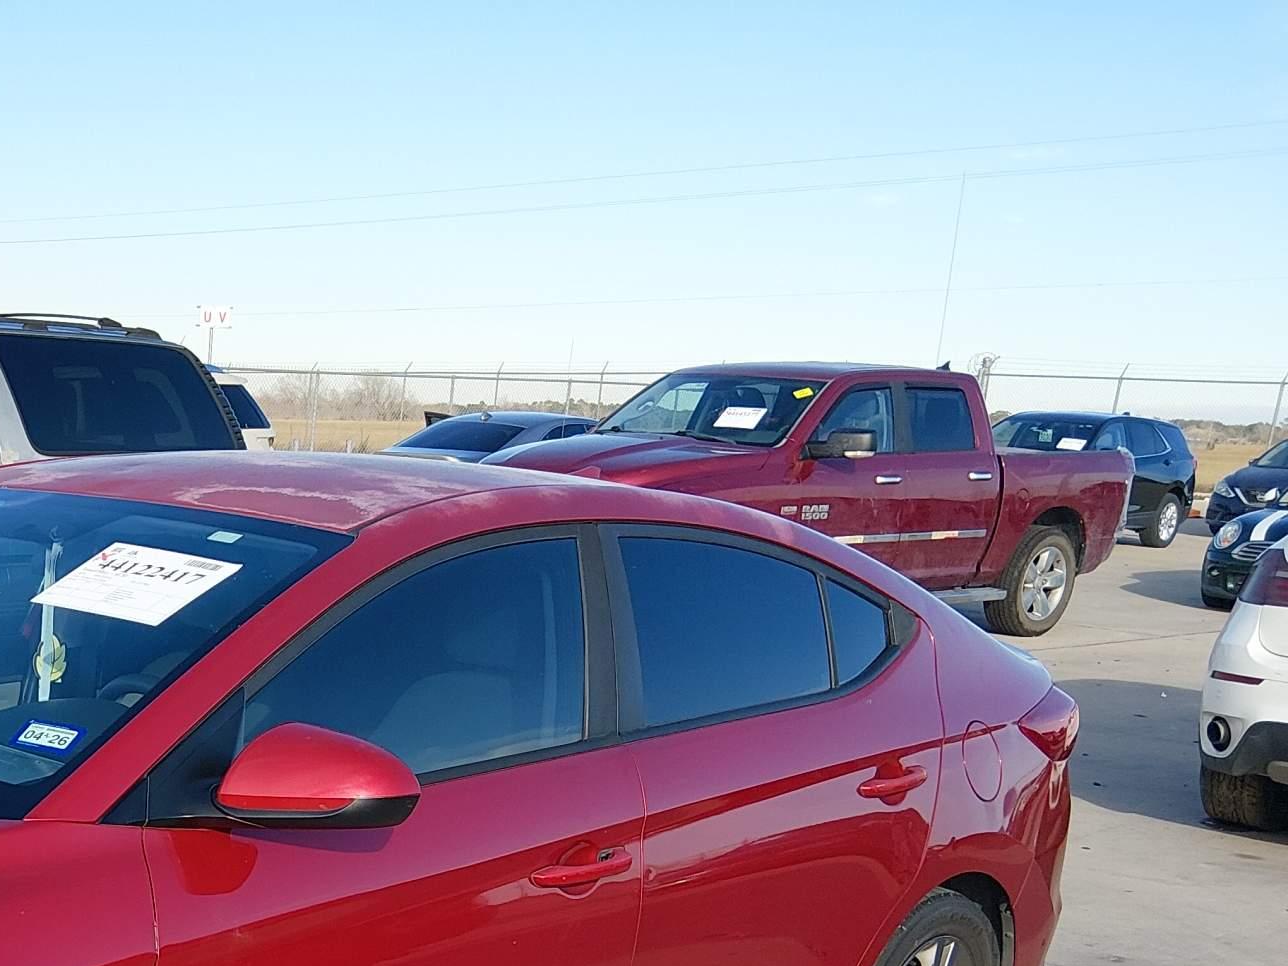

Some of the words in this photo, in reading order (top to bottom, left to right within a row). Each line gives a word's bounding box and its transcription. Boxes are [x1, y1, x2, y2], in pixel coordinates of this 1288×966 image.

[204, 311, 212, 323] U
[219, 311, 227, 324] V
[801, 504, 830, 512] RAM
[801, 512, 829, 520] 1500
[98, 558, 206, 584] 44122417
[47, 734, 71, 746] 26
